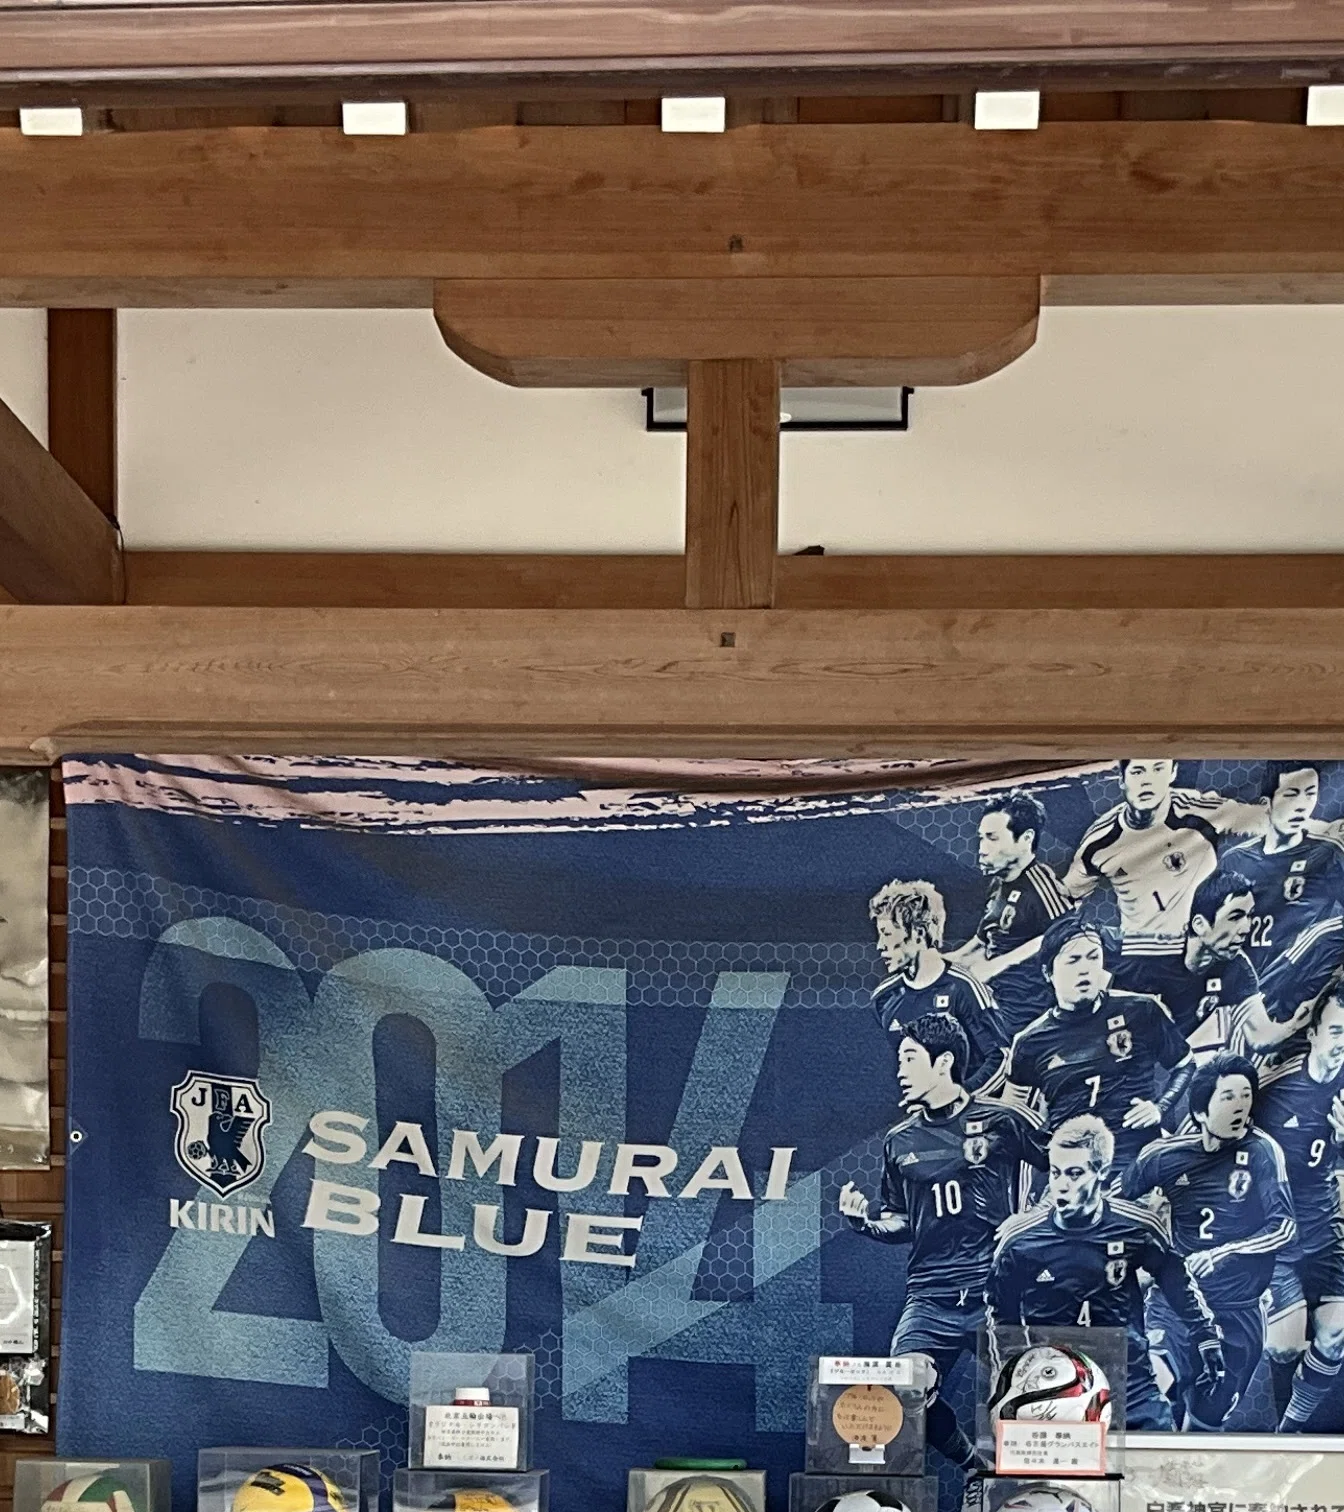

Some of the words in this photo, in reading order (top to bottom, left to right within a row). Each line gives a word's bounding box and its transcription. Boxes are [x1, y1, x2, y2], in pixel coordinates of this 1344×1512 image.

[190, 1085, 255, 1116] JFA
[1084, 1074, 1101, 1108] 7
[301, 1109, 799, 1201] SAMURAI
[1307, 1138, 1326, 1169] 9
[133, 915, 856, 1433] 2014
[931, 1180, 963, 1218] 10
[169, 1197, 276, 1240] KIRIN
[299, 1178, 644, 1268] BLUE
[1198, 1207, 1215, 1241] 2
[1076, 1300, 1091, 1328] 4
